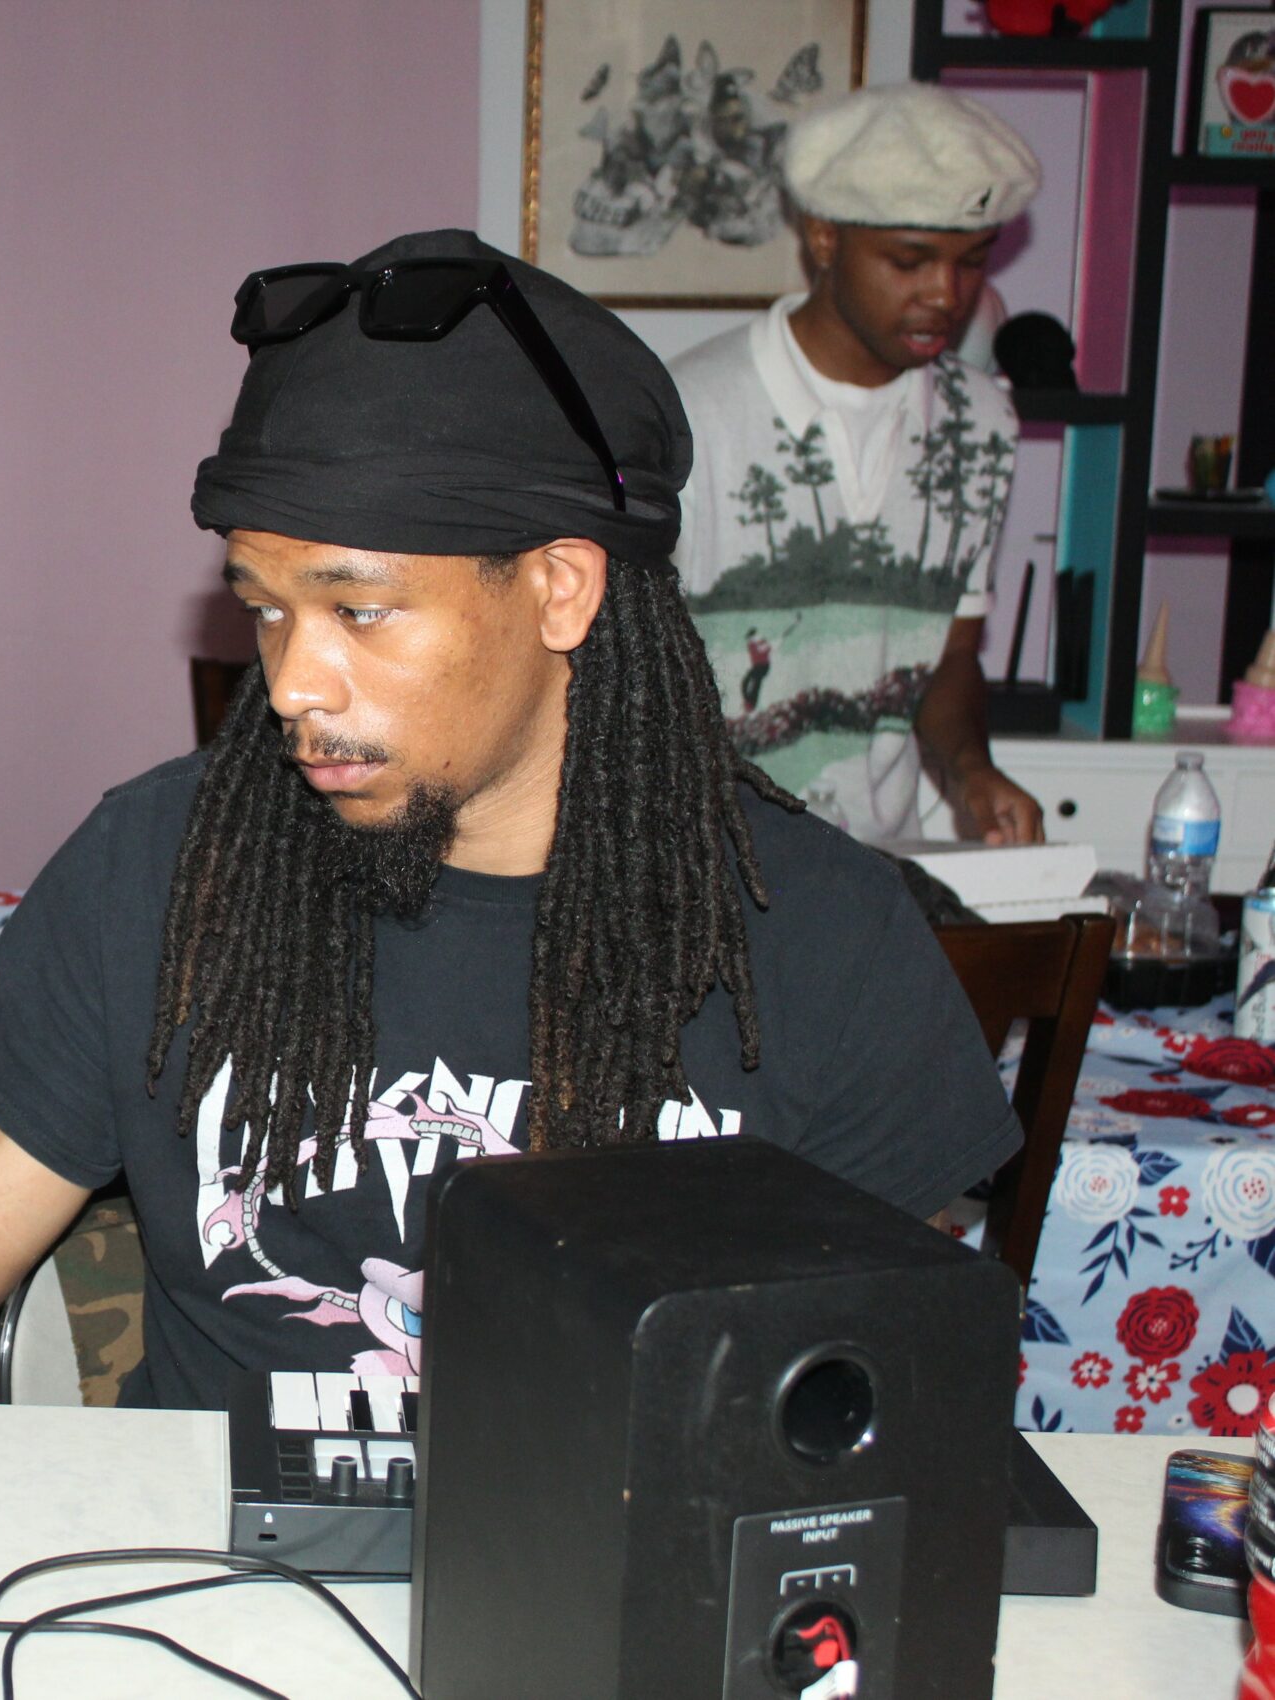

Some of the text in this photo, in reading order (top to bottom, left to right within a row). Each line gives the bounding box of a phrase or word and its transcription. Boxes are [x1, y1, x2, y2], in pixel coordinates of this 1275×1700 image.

[770, 1508, 873, 1534] PASSIVE SPEAKER
[802, 1527, 839, 1543] INPUT
